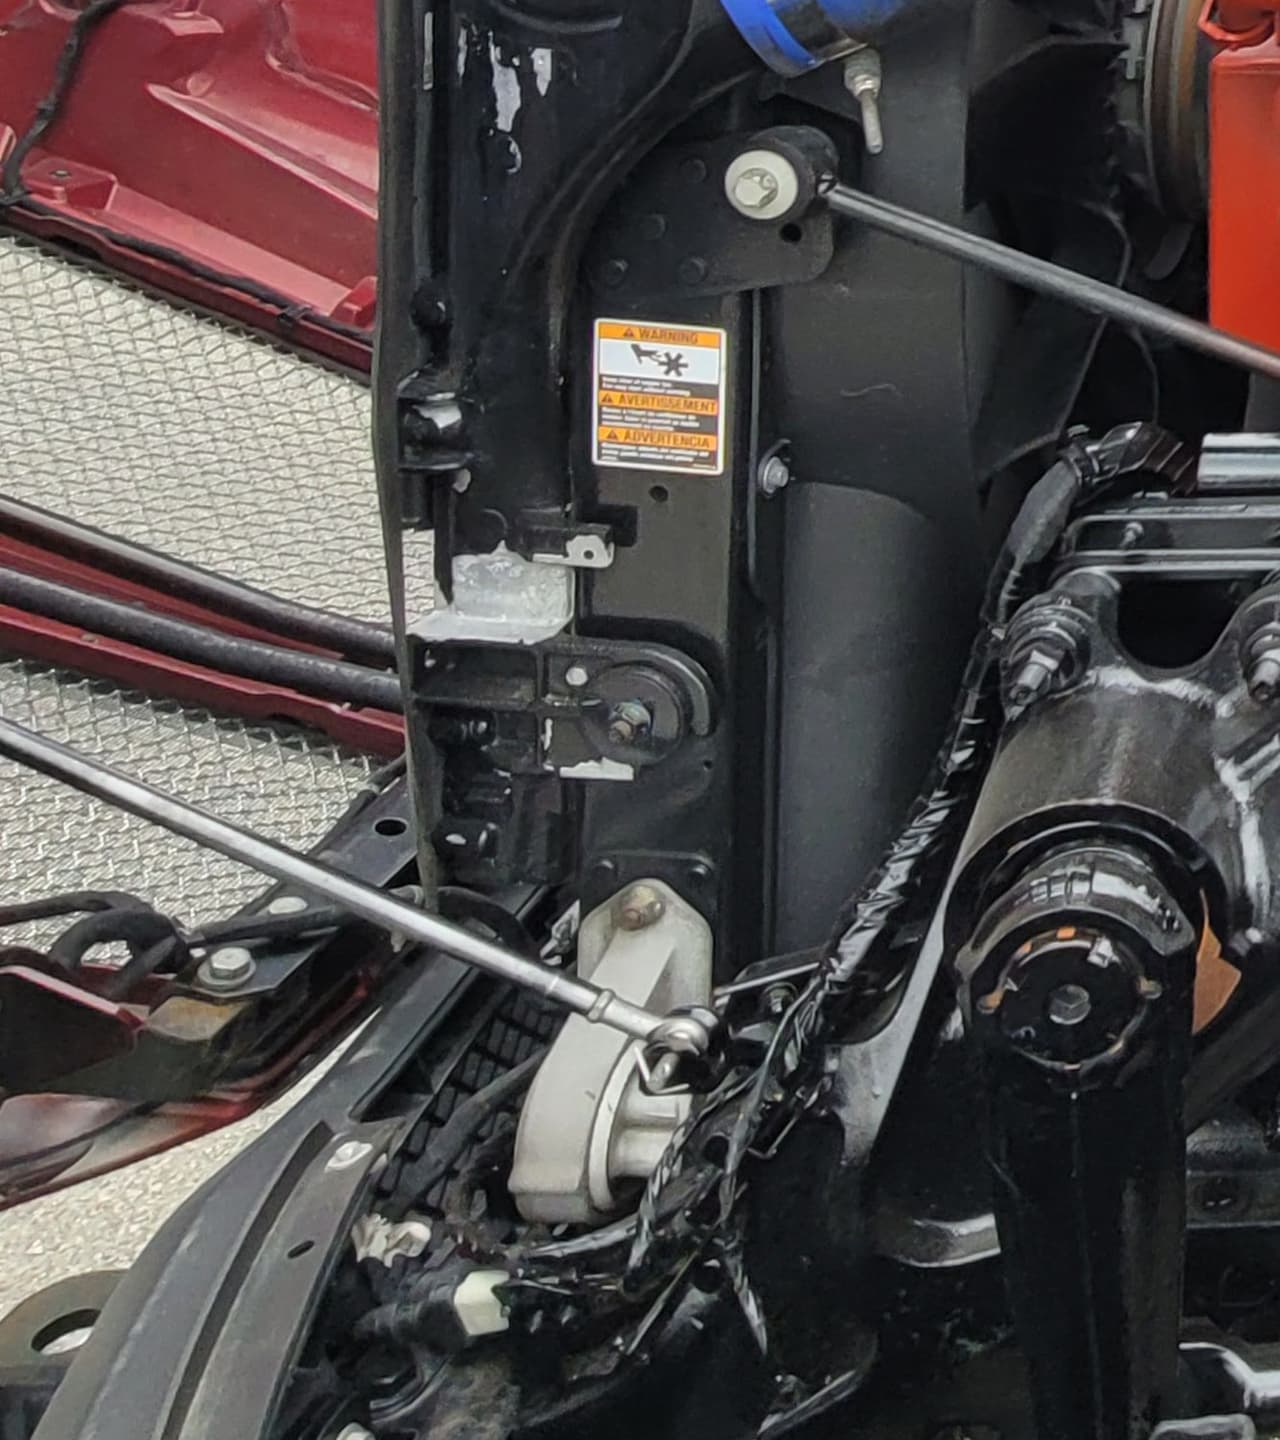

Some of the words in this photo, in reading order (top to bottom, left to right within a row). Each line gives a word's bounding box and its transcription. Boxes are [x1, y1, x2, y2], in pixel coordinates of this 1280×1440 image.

[638, 327, 699, 345] WARNING
[618, 394, 716, 413] AVERTISSEMENT
[624, 431, 710, 449] ADVERTENCIA
